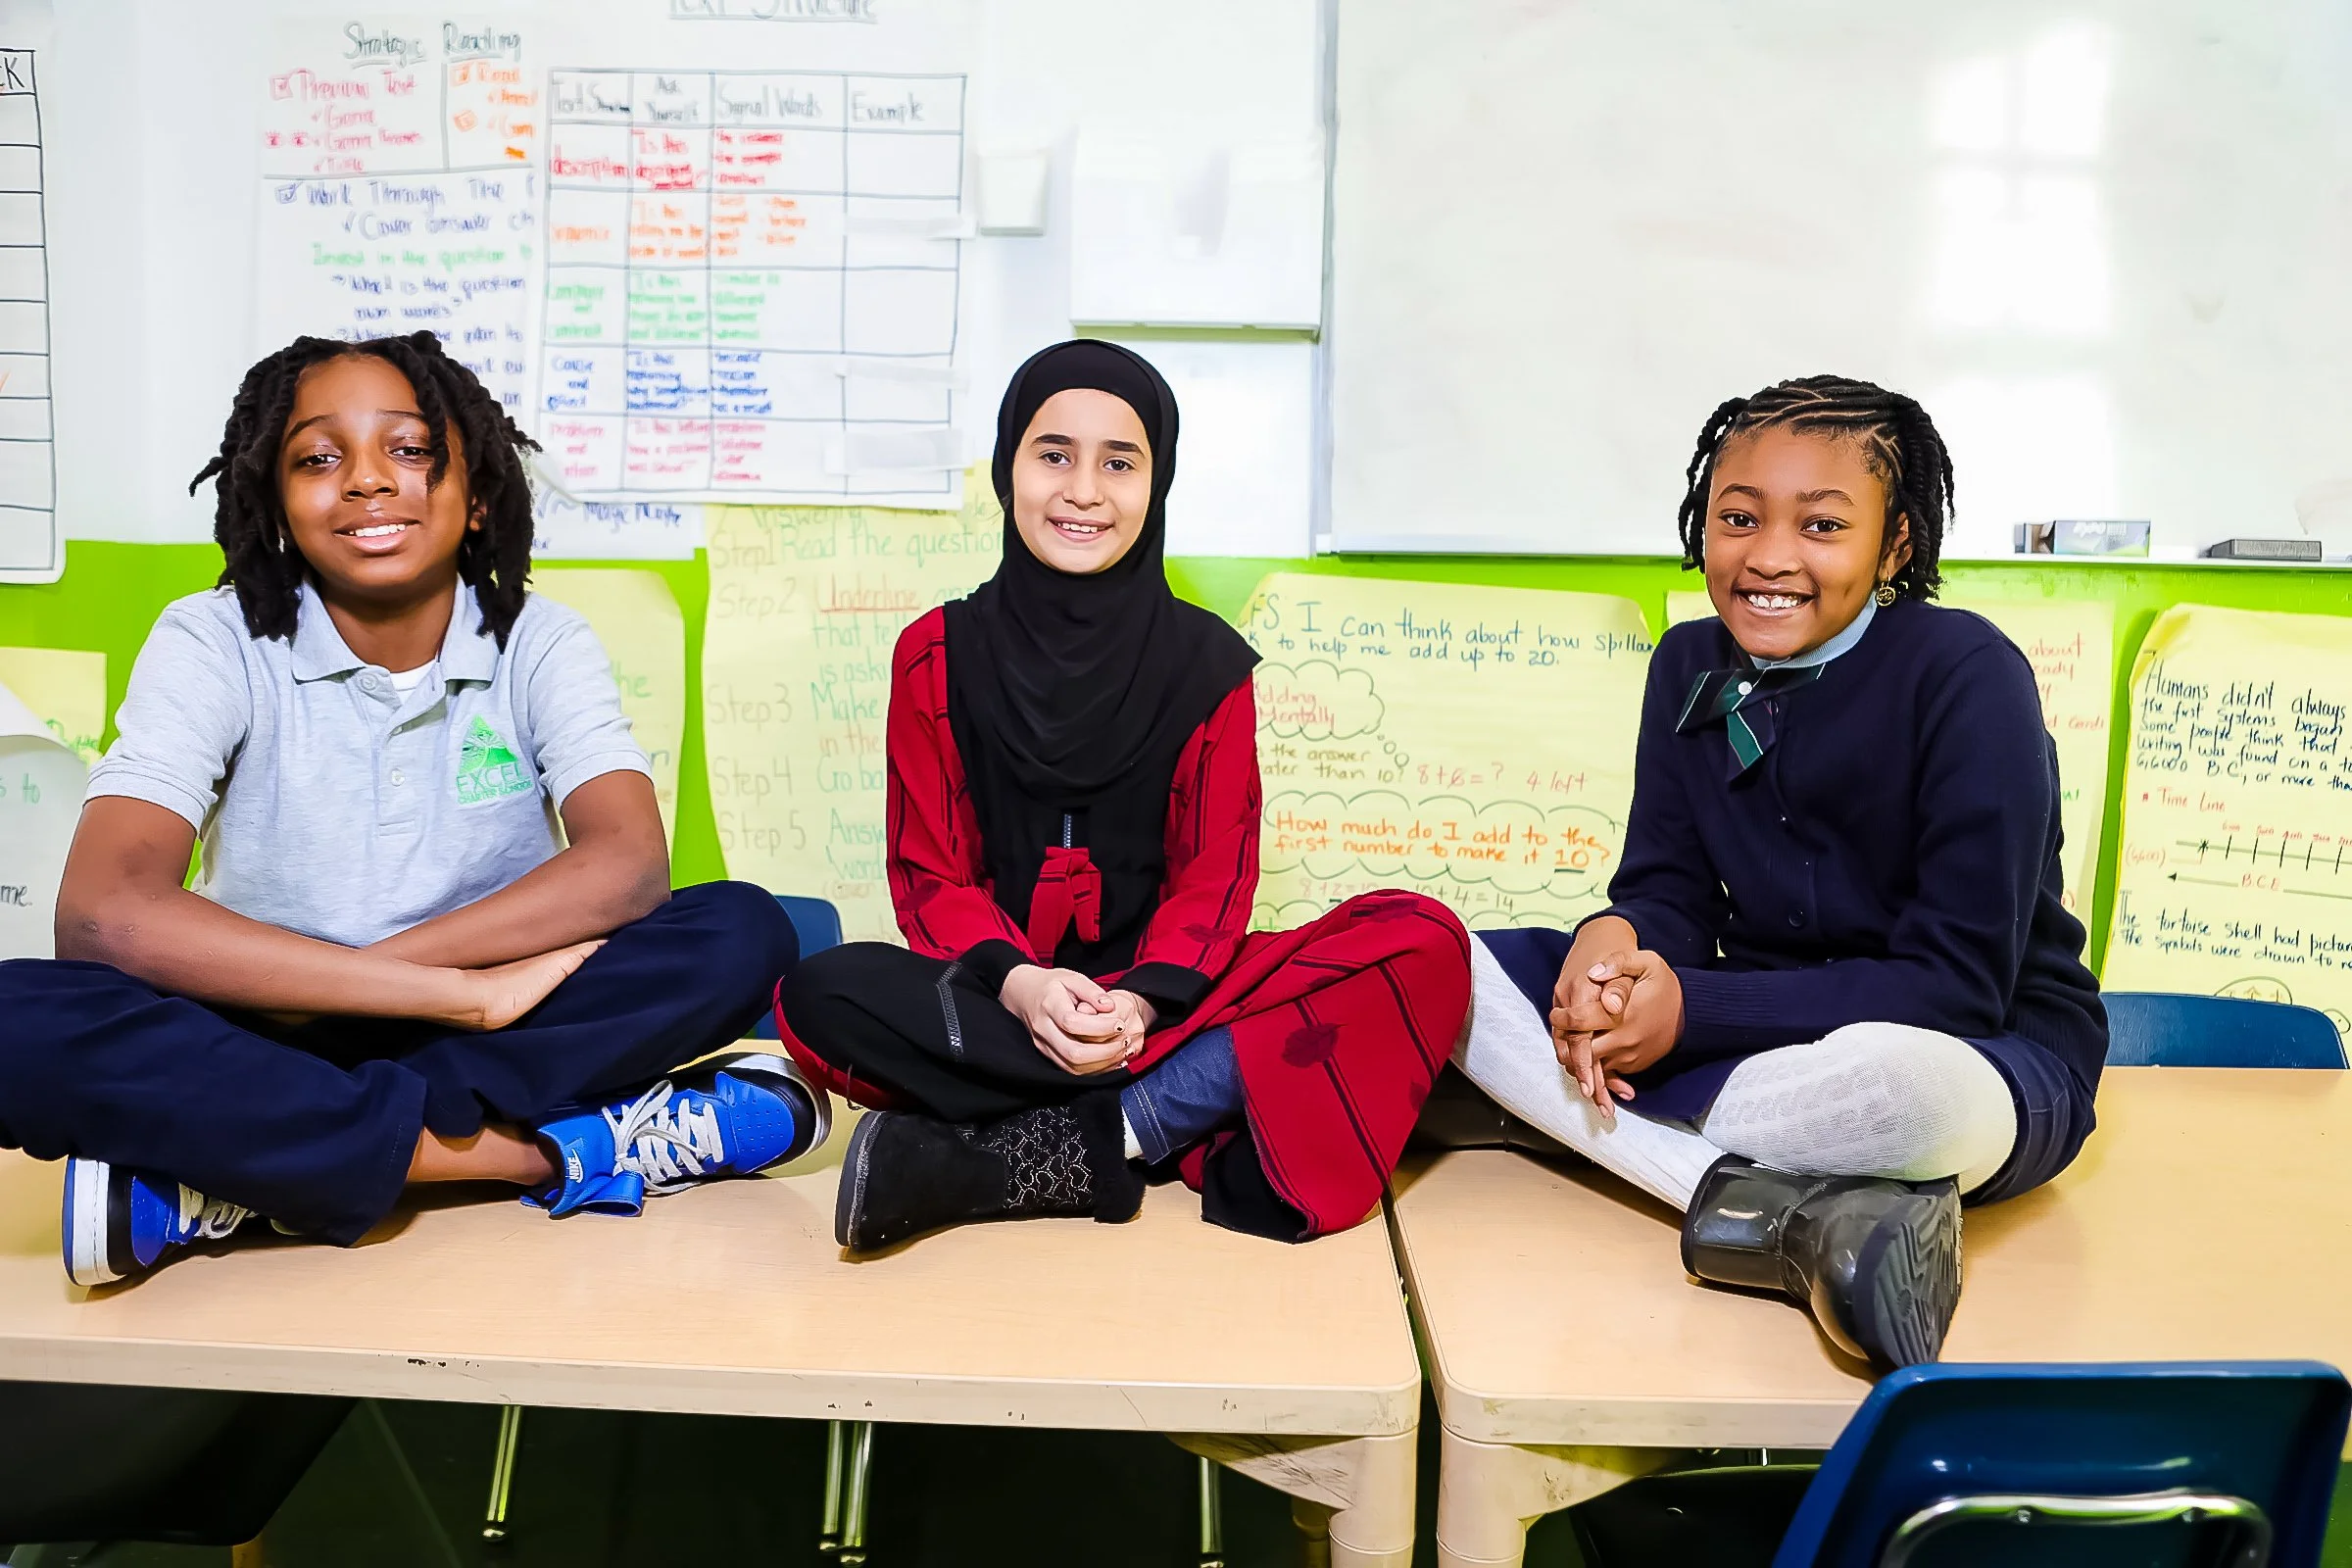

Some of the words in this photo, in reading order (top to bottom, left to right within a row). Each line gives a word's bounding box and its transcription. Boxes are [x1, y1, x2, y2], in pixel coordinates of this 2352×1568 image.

[782, 522, 837, 561] Read
[850, 519, 897, 558] the
[813, 573, 919, 610] Underline
[1296, 602, 1323, 633] I
[1395, 608, 1452, 643] think
[1465, 619, 1525, 647] about
[1538, 625, 1581, 650] how
[1278, 632, 1296, 650] to
[1309, 637, 1348, 662] help
[1360, 645, 1392, 657] me
[1409, 644, 1448, 661] add
[1460, 650, 1485, 671] up
[1495, 647, 1515, 663] to
[1529, 650, 1561, 666] 20.
[2145, 658, 2209, 701] Humans
[811, 681, 880, 722] Make
[2245, 728, 2284, 748] think
[2299, 735, 2338, 757] that
[2295, 716, 2343, 741] began
[1314, 762, 1365, 779] than
[2236, 745, 2278, 768] found
[2289, 757, 2310, 769] on
[2320, 760, 2328, 772] a
[456, 761, 531, 795] EXCEL
[2158, 786, 2188, 807] Time
[1274, 810, 1327, 833] How
[1342, 818, 1397, 837] much
[1407, 820, 1432, 840] do
[1442, 822, 1460, 840] I
[1474, 821, 1511, 845] add
[1521, 825, 1548, 847] to
[1561, 825, 1598, 850] the
[1274, 835, 1333, 856] first
[1343, 837, 1413, 857] number
[1427, 836, 1448, 858] to
[1456, 846, 1507, 863] make
[1524, 849, 1539, 865] it
[2156, 907, 2212, 934] tortoise
[2274, 926, 2300, 949] had
[2210, 944, 2242, 958] were
[2254, 945, 2305, 964] drawn
[2314, 953, 2332, 967] to
[567, 1156, 580, 1180] NIKE
